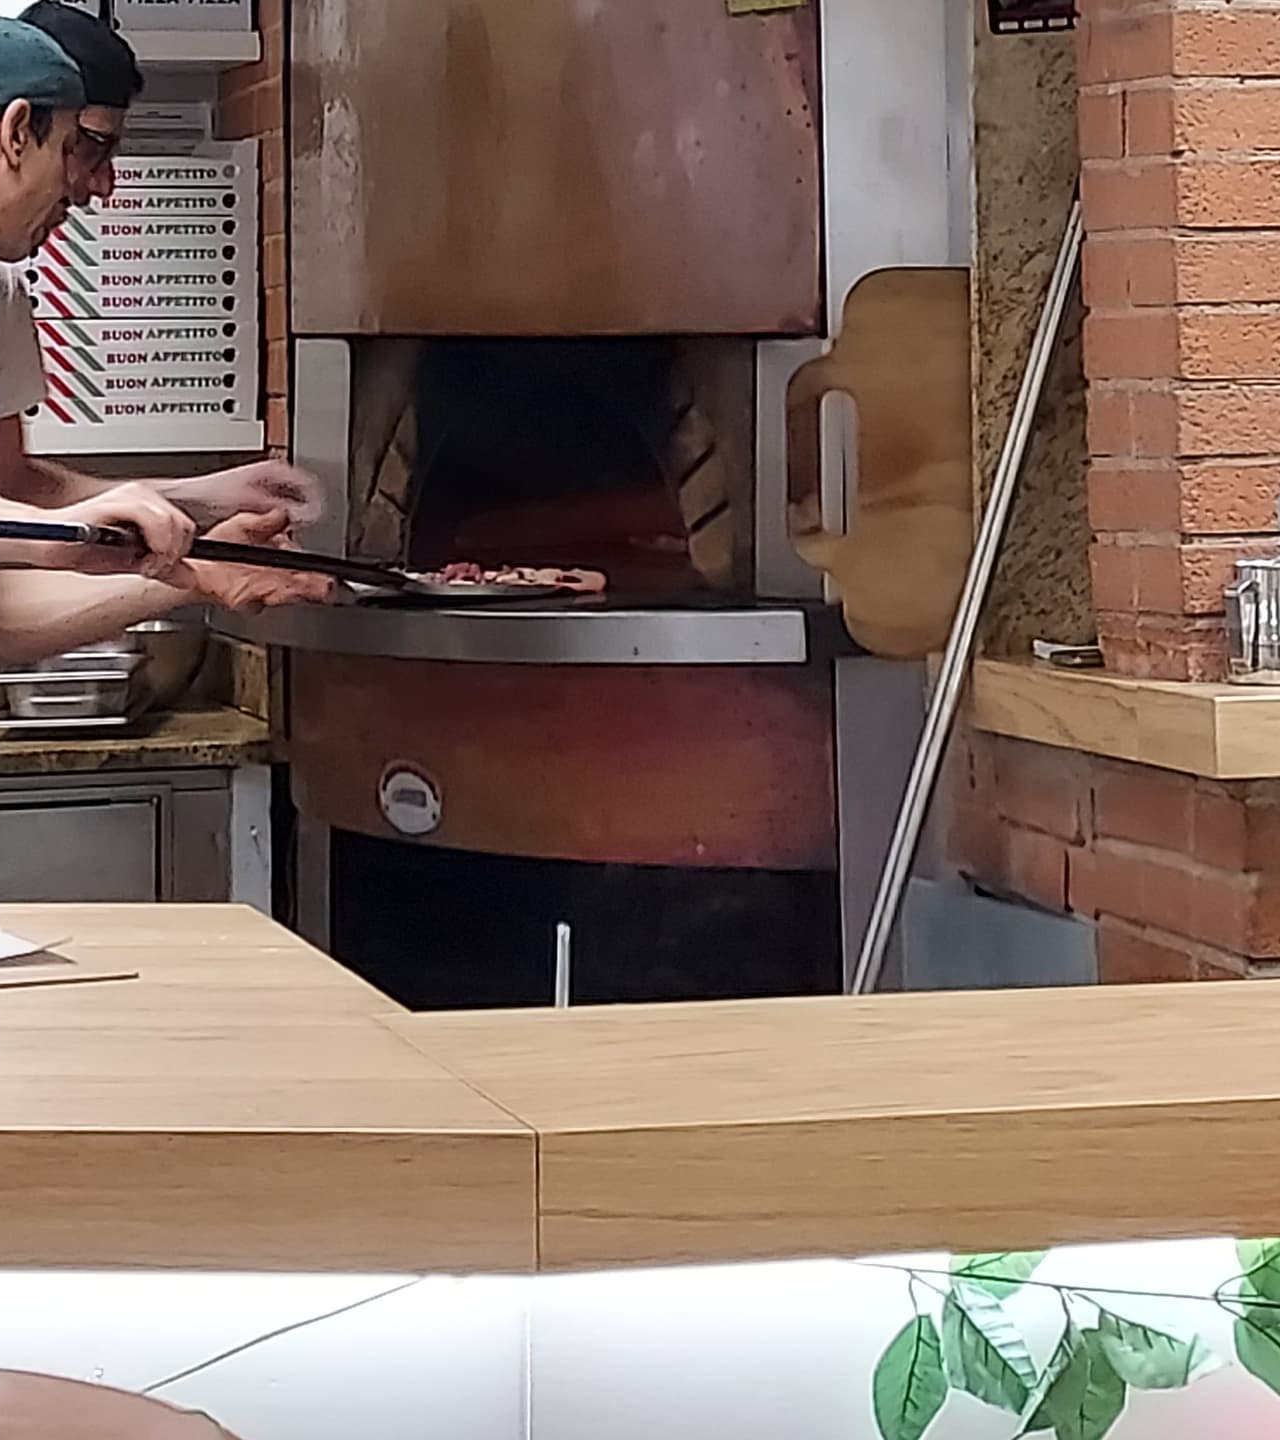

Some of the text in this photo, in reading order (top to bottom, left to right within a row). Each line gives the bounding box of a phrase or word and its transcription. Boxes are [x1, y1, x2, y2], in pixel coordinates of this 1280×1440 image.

[115, 168, 217, 179] UON APPETITO
[145, 198, 217, 209] APPETITO
[101, 224, 216, 235] BUON APPETITO
[102, 249, 217, 260] BUON APPETITO
[101, 274, 217, 285] BUON APPETITO
[102, 296, 217, 307] BUON APPETITO
[102, 328, 217, 341] BUON APPETITO
[106, 351, 223, 363] BUON APPETITO
[106, 377, 222, 389] BUON APPETITO
[105, 402, 221, 415] BUON APPETITO
